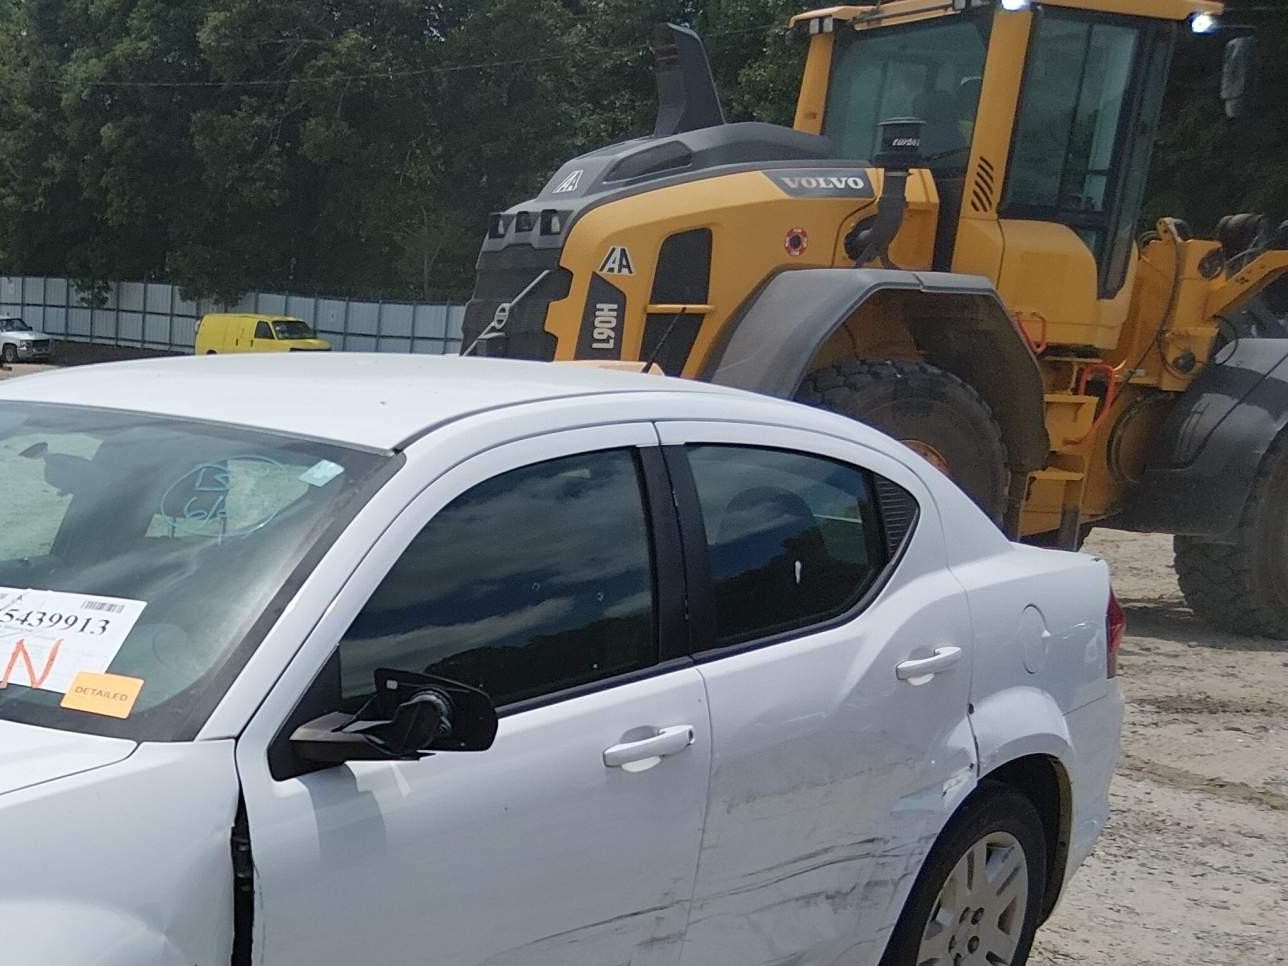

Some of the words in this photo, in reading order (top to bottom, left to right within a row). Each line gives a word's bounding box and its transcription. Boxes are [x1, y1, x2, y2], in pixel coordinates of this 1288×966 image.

[781, 177, 864, 189] VOLVO
[592, 303, 618, 349] L90H
[0, 638, 64, 689] N
[74, 686, 129, 702] DETAILED
